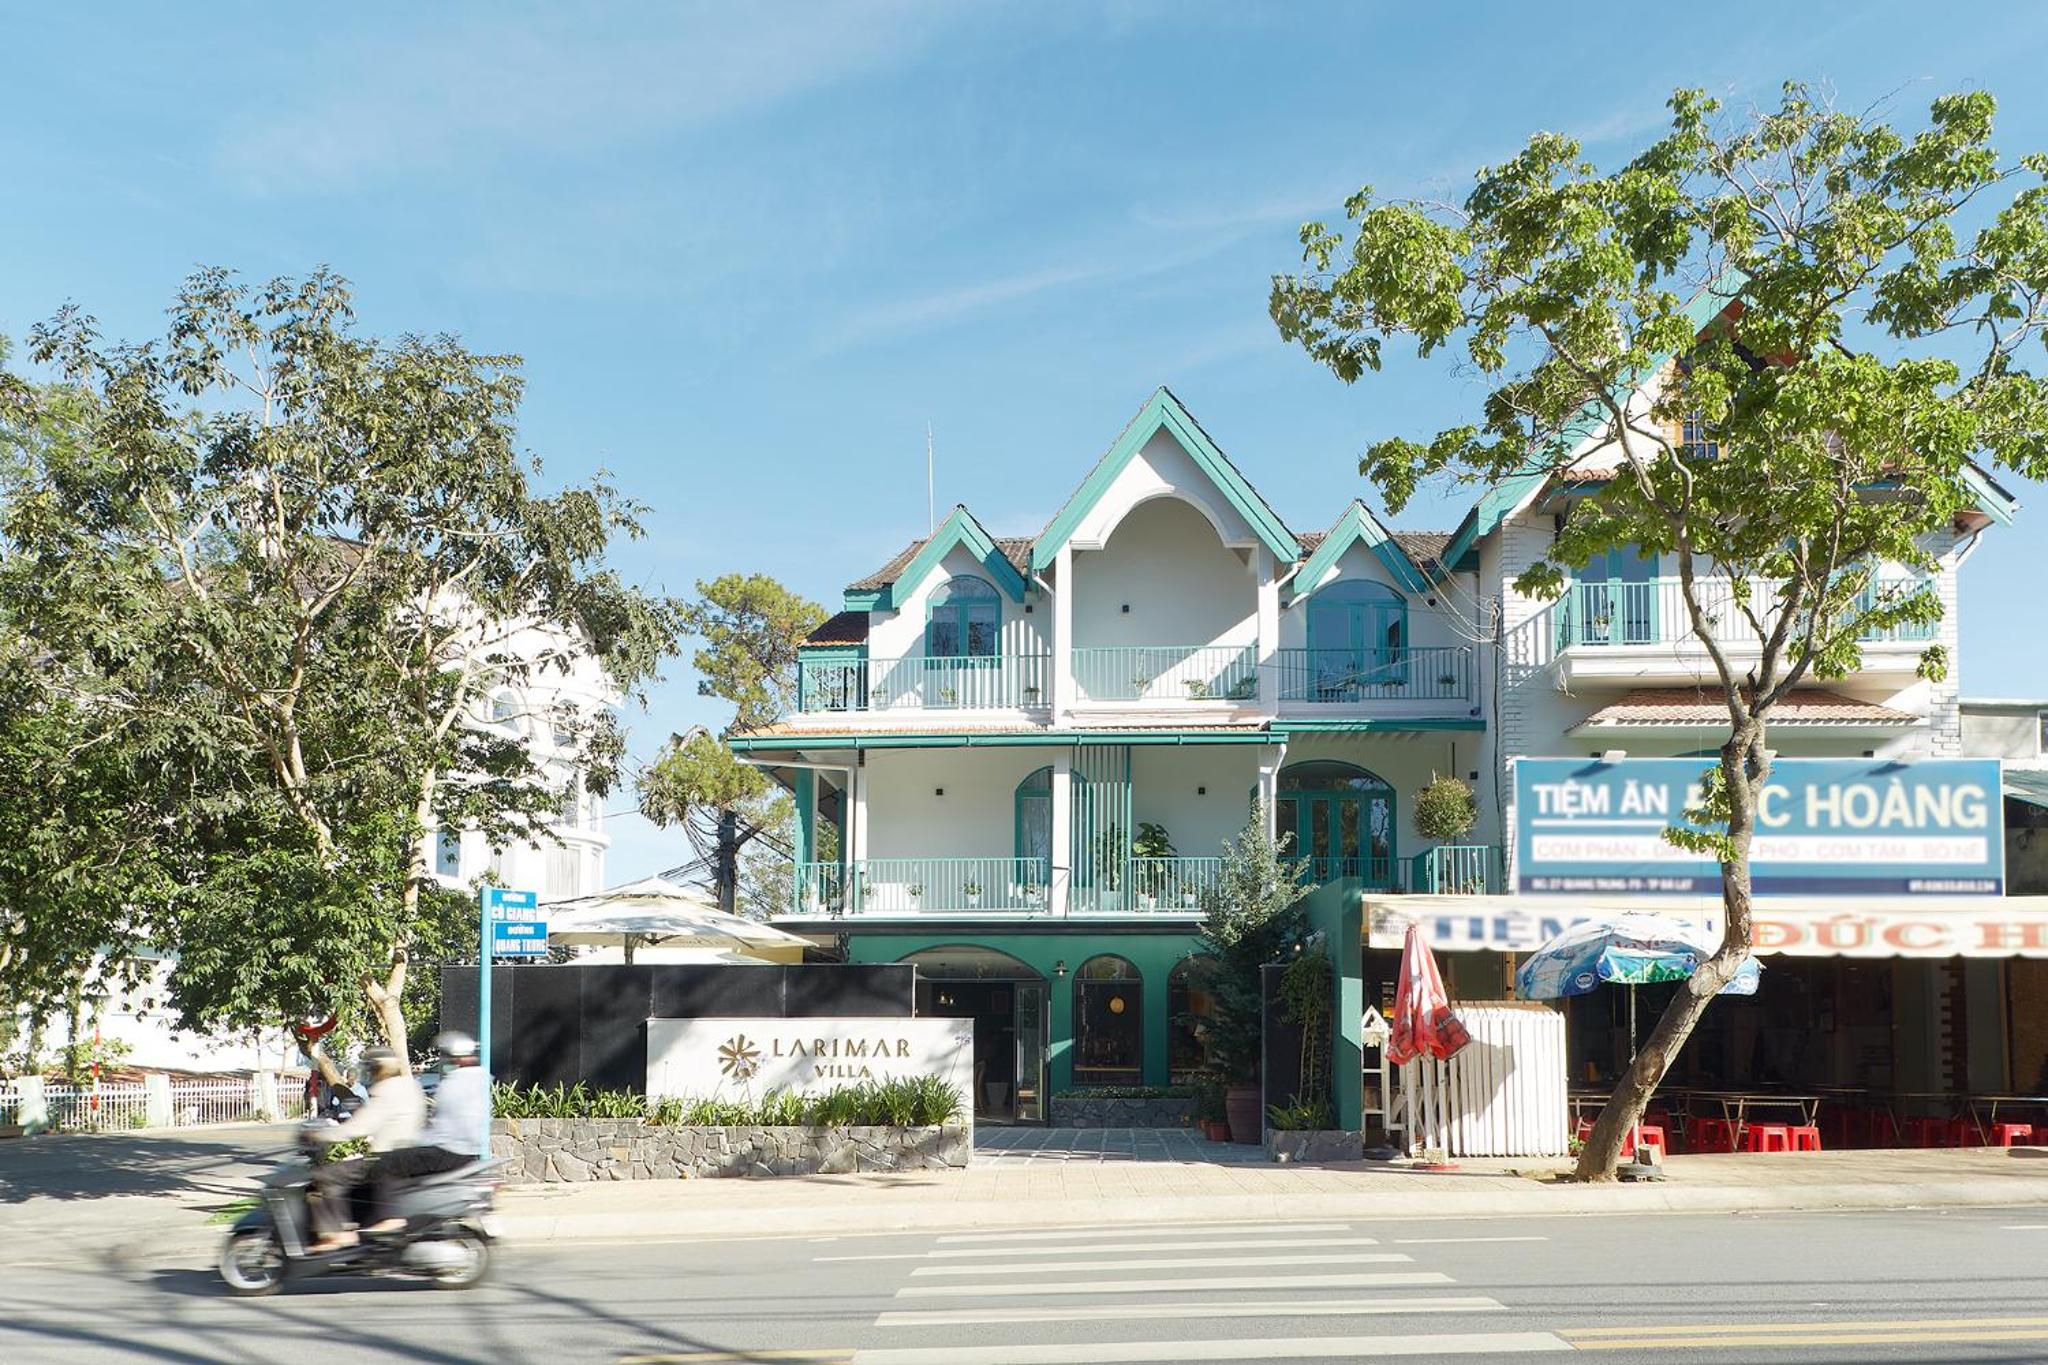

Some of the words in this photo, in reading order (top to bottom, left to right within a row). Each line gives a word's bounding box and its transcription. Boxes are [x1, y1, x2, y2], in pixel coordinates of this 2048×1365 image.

[1532, 780, 1610, 818] TIỆM
[1621, 779, 1668, 814] ĂN
[1805, 778, 1988, 829] HOÀNG
[773, 1038, 910, 1057] LARIMAR
[814, 1065, 871, 1078] VILLA
